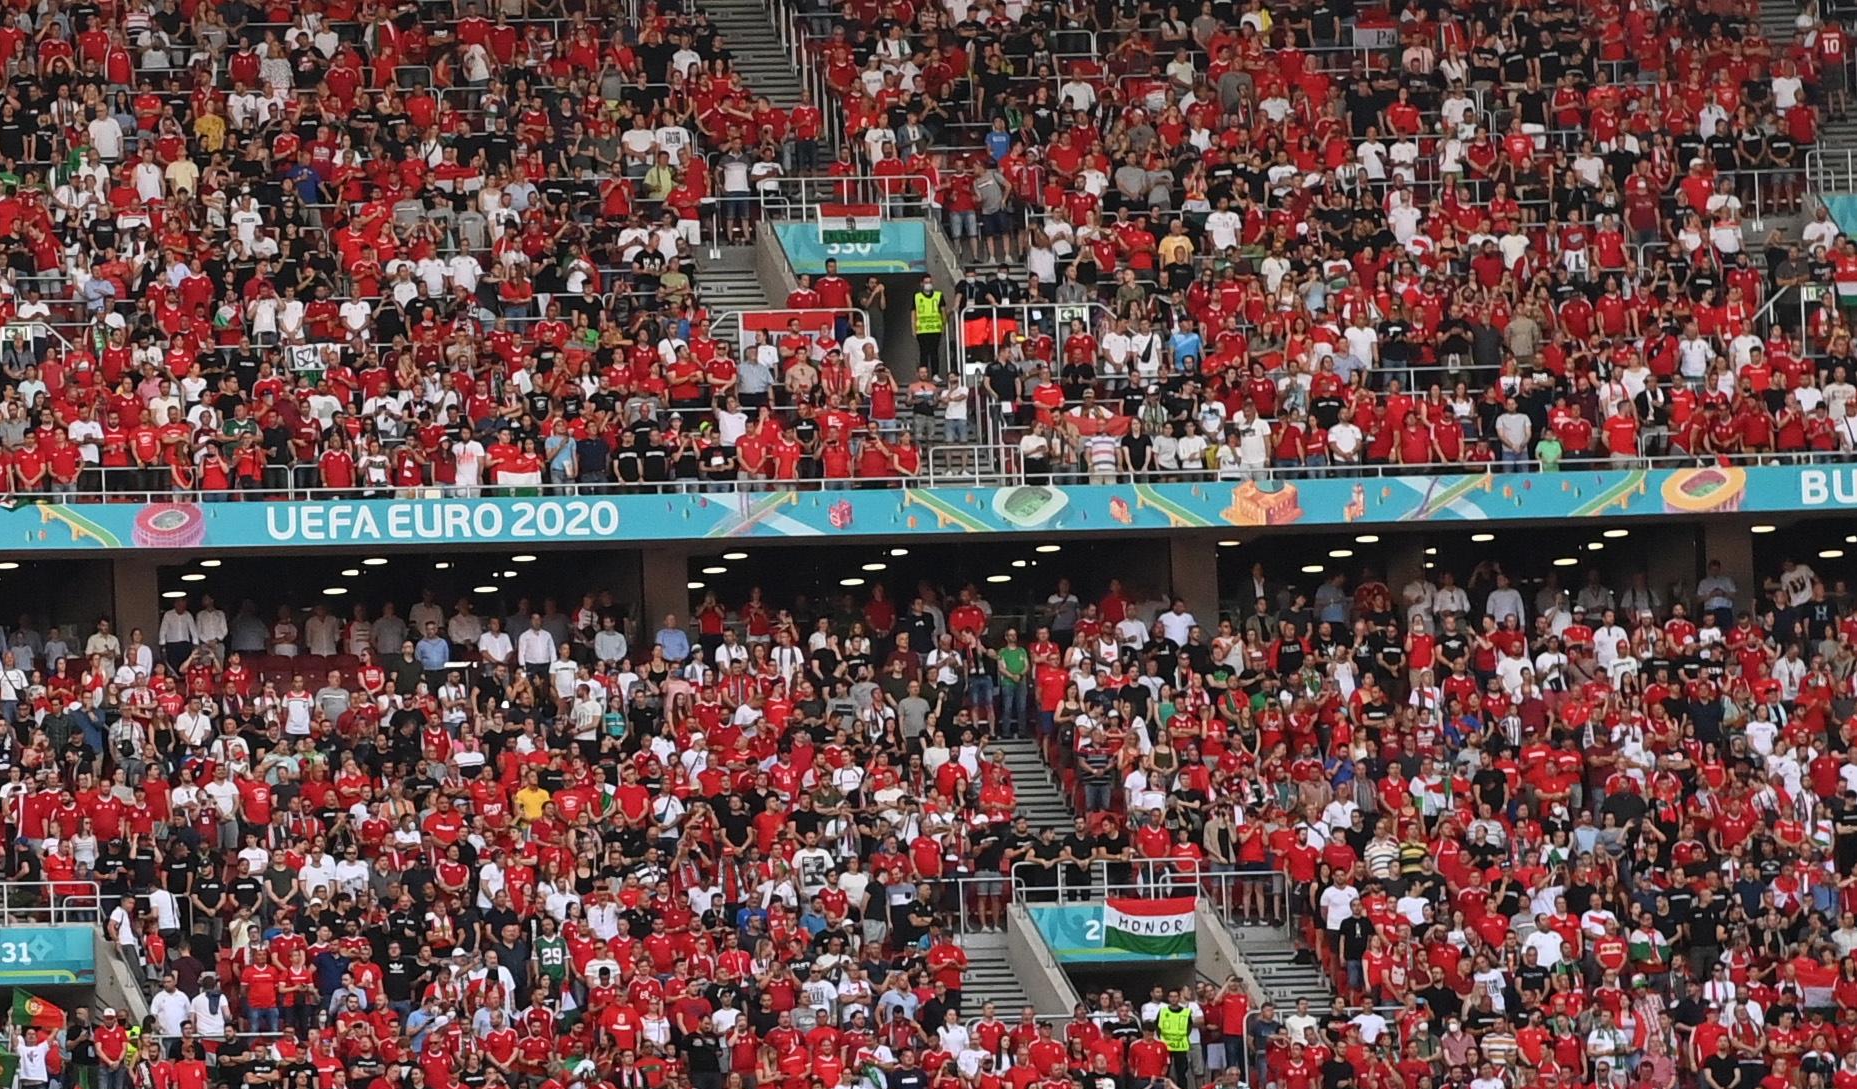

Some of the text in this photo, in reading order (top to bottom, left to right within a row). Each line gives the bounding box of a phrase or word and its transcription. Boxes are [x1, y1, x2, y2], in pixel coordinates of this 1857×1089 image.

[1822, 39, 1840, 54] 10
[1801, 470, 1857, 505] BU
[267, 501, 619, 540] UEFA EURO 2020
[1117, 917, 1183, 934] MONOR
[541, 948, 563, 966] 29
